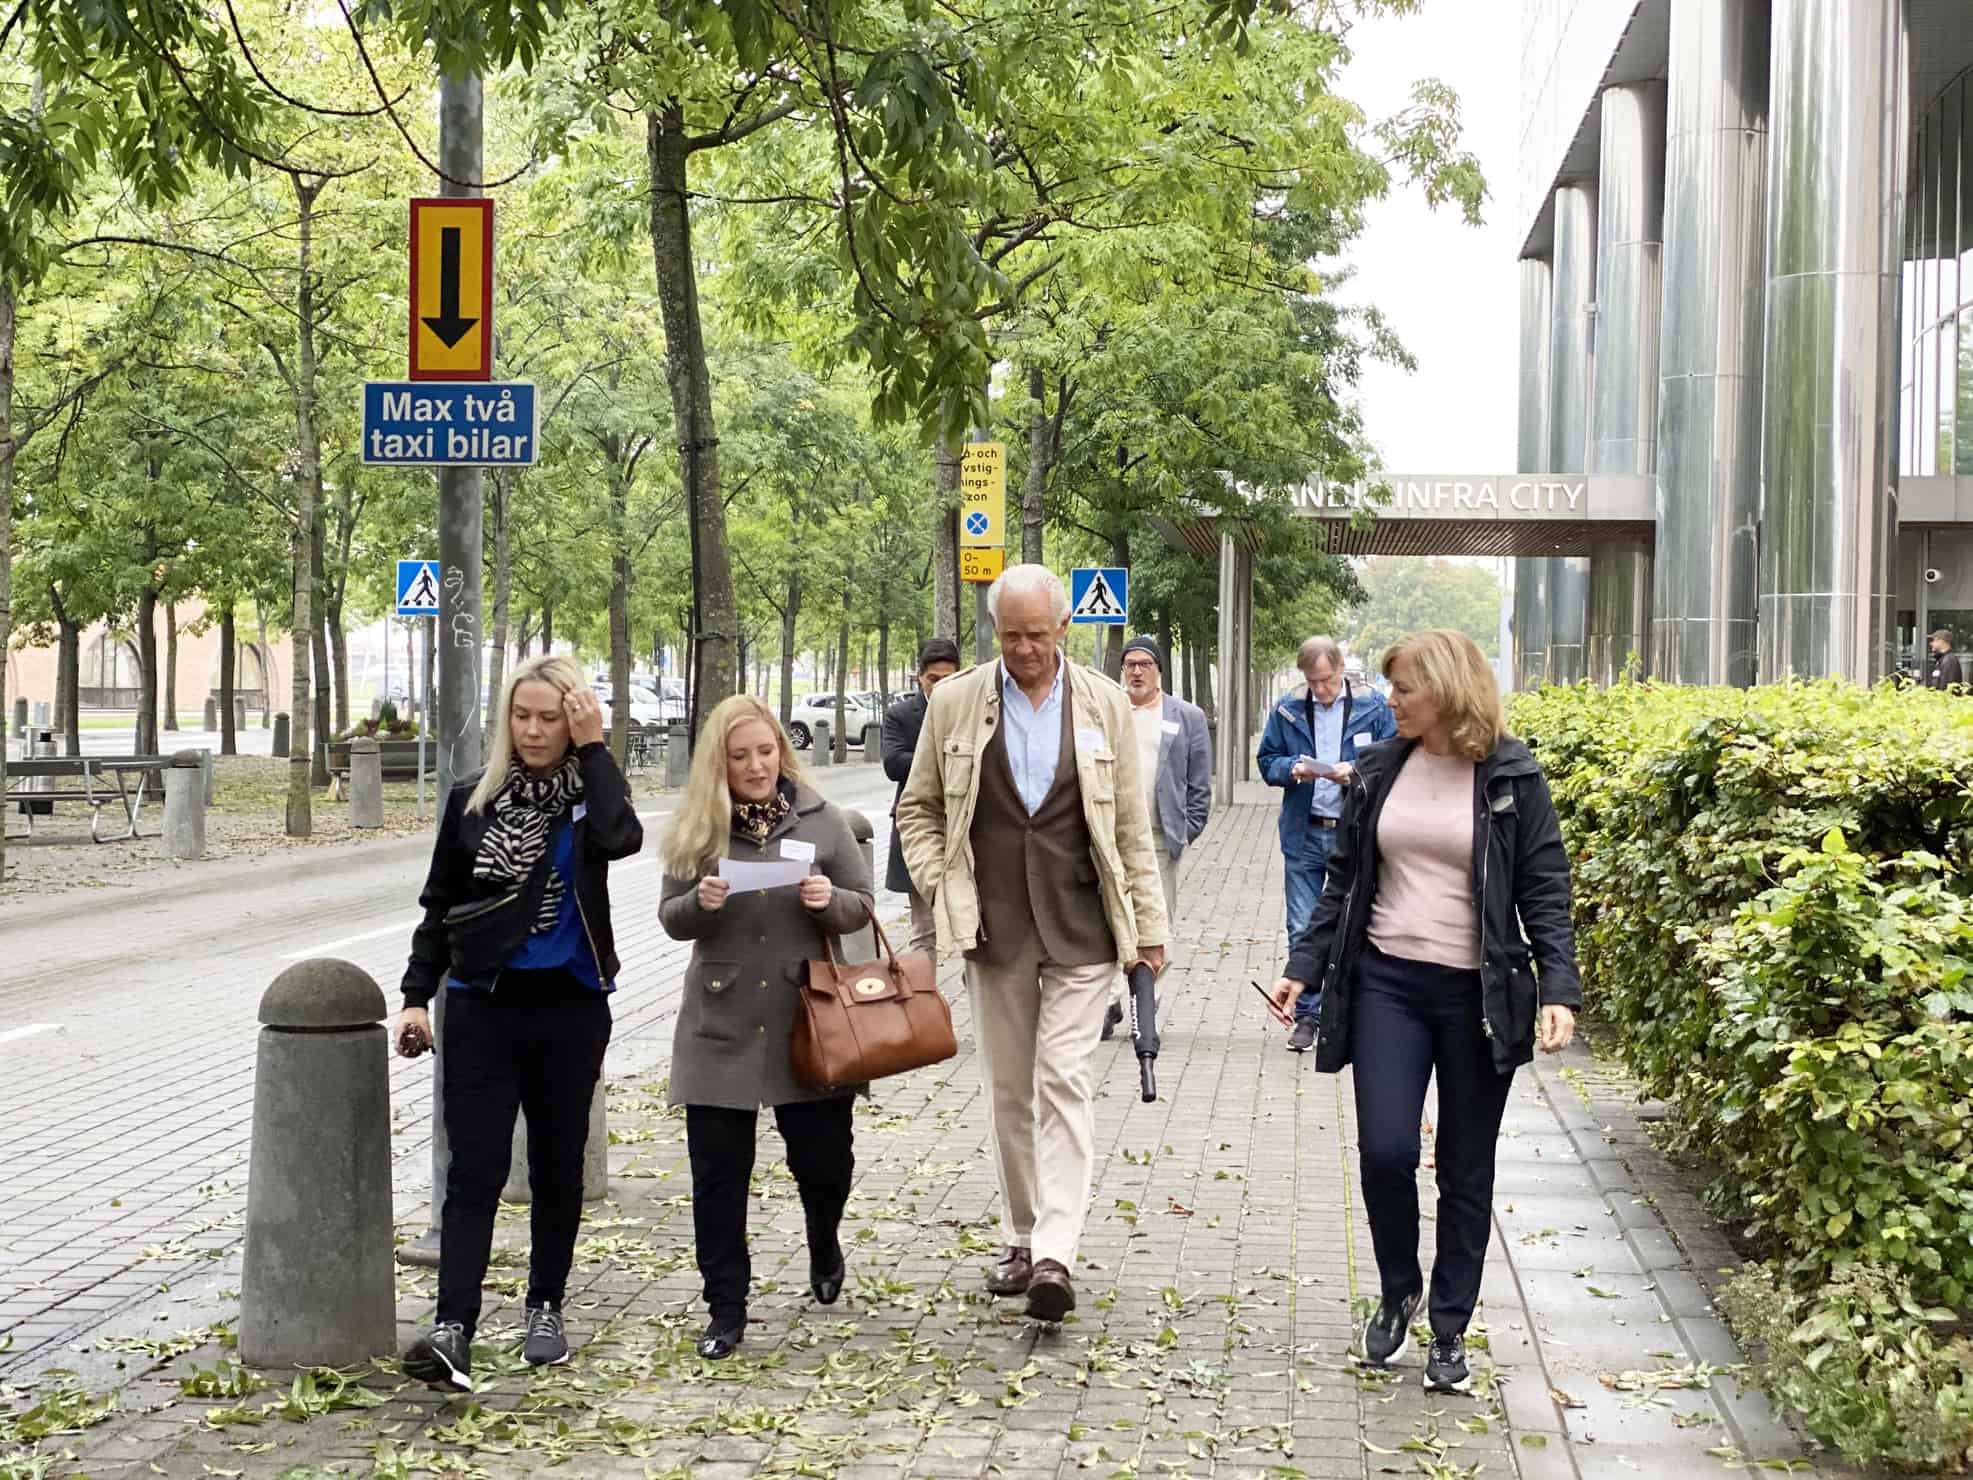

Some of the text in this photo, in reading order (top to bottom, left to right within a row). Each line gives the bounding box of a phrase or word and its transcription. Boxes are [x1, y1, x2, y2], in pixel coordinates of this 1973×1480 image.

[383, 389, 515, 421] Max två
[371, 428, 527, 458] taxi bilar
[977, 448, 997, 458] och
[963, 463, 999, 475] vstig-
[1396, 481, 1498, 509] INFRA
[1509, 483, 1584, 510] CITY
[964, 565, 979, 575] 50
